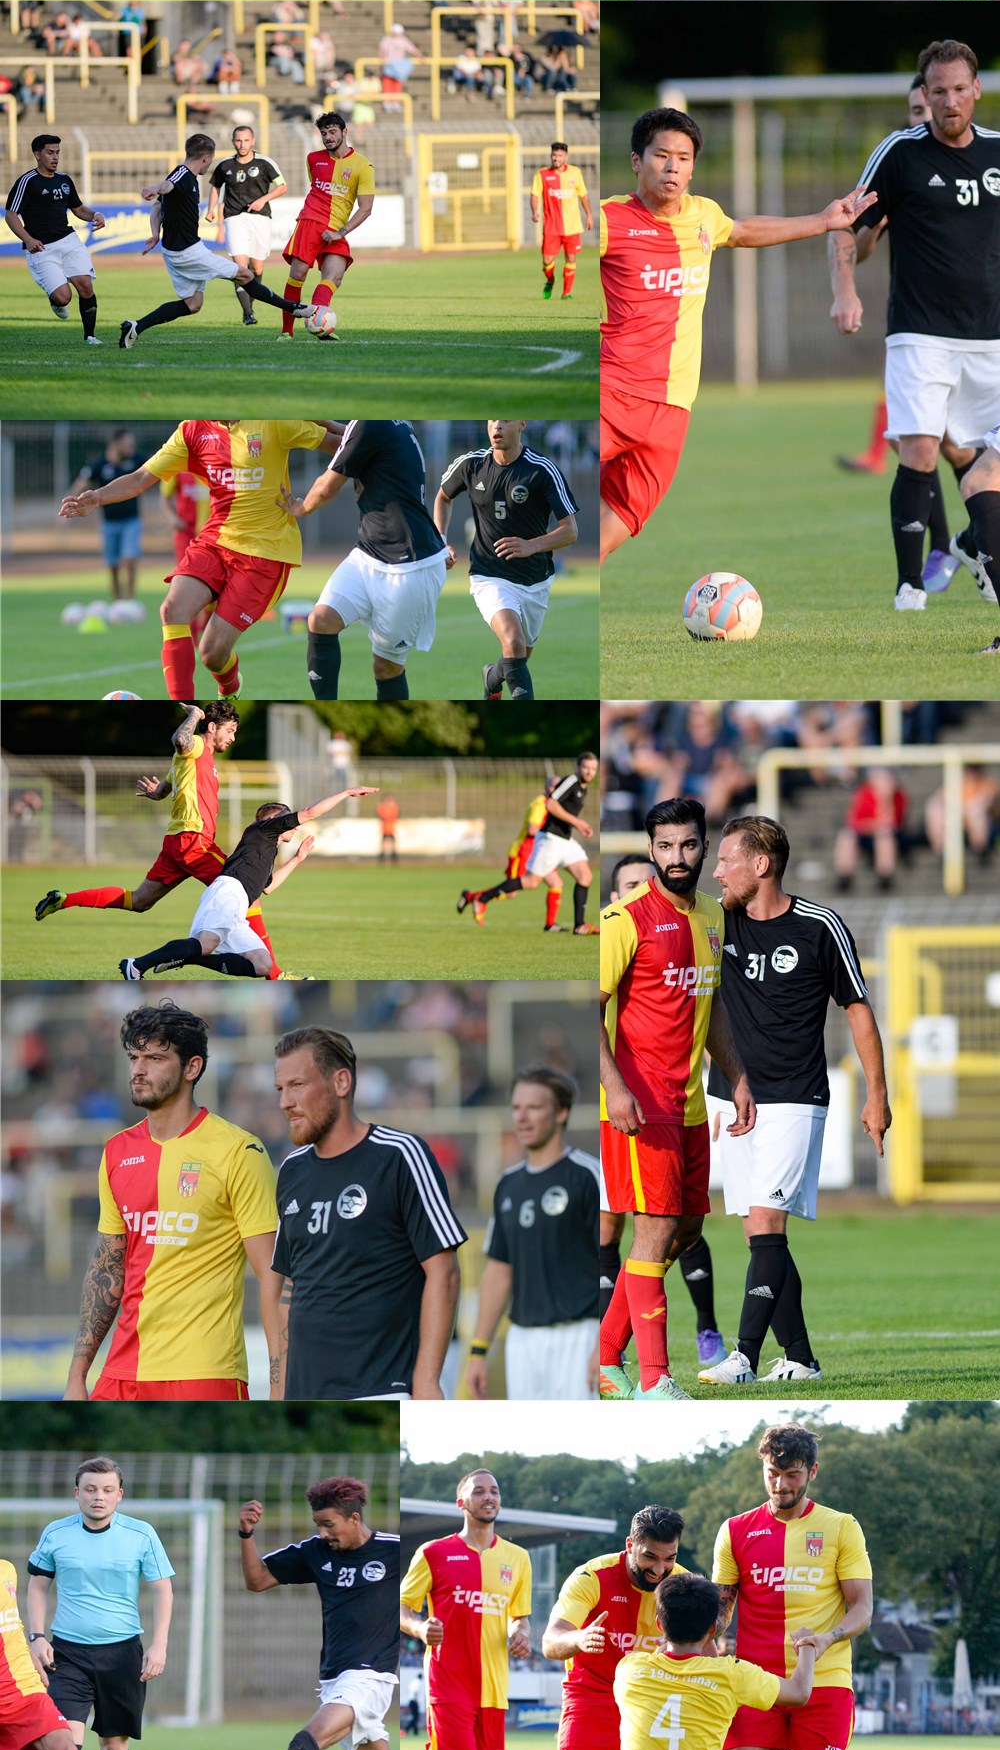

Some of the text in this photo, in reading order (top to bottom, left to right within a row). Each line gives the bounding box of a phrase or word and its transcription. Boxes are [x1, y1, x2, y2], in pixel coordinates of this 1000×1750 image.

[53, 188, 63, 200] 21
[314, 177, 349, 194] tipico
[955, 179, 979, 206] 31
[207, 465, 265, 484] tipico
[494, 501, 507, 520] 5
[654, 921, 679, 934] Joma
[744, 953, 766, 982] 31
[119, 1155, 145, 1167] Joma
[122, 1205, 199, 1236] tipico
[307, 1201, 332, 1234] 31
[518, 1199, 535, 1228] 6
[746, 1529, 772, 1538] Joma
[336, 1567, 357, 1587] 23
[750, 1563, 824, 1586] tipico
[452, 1585, 510, 1608] tipico
[682, 1673, 719, 1691] Hanau
